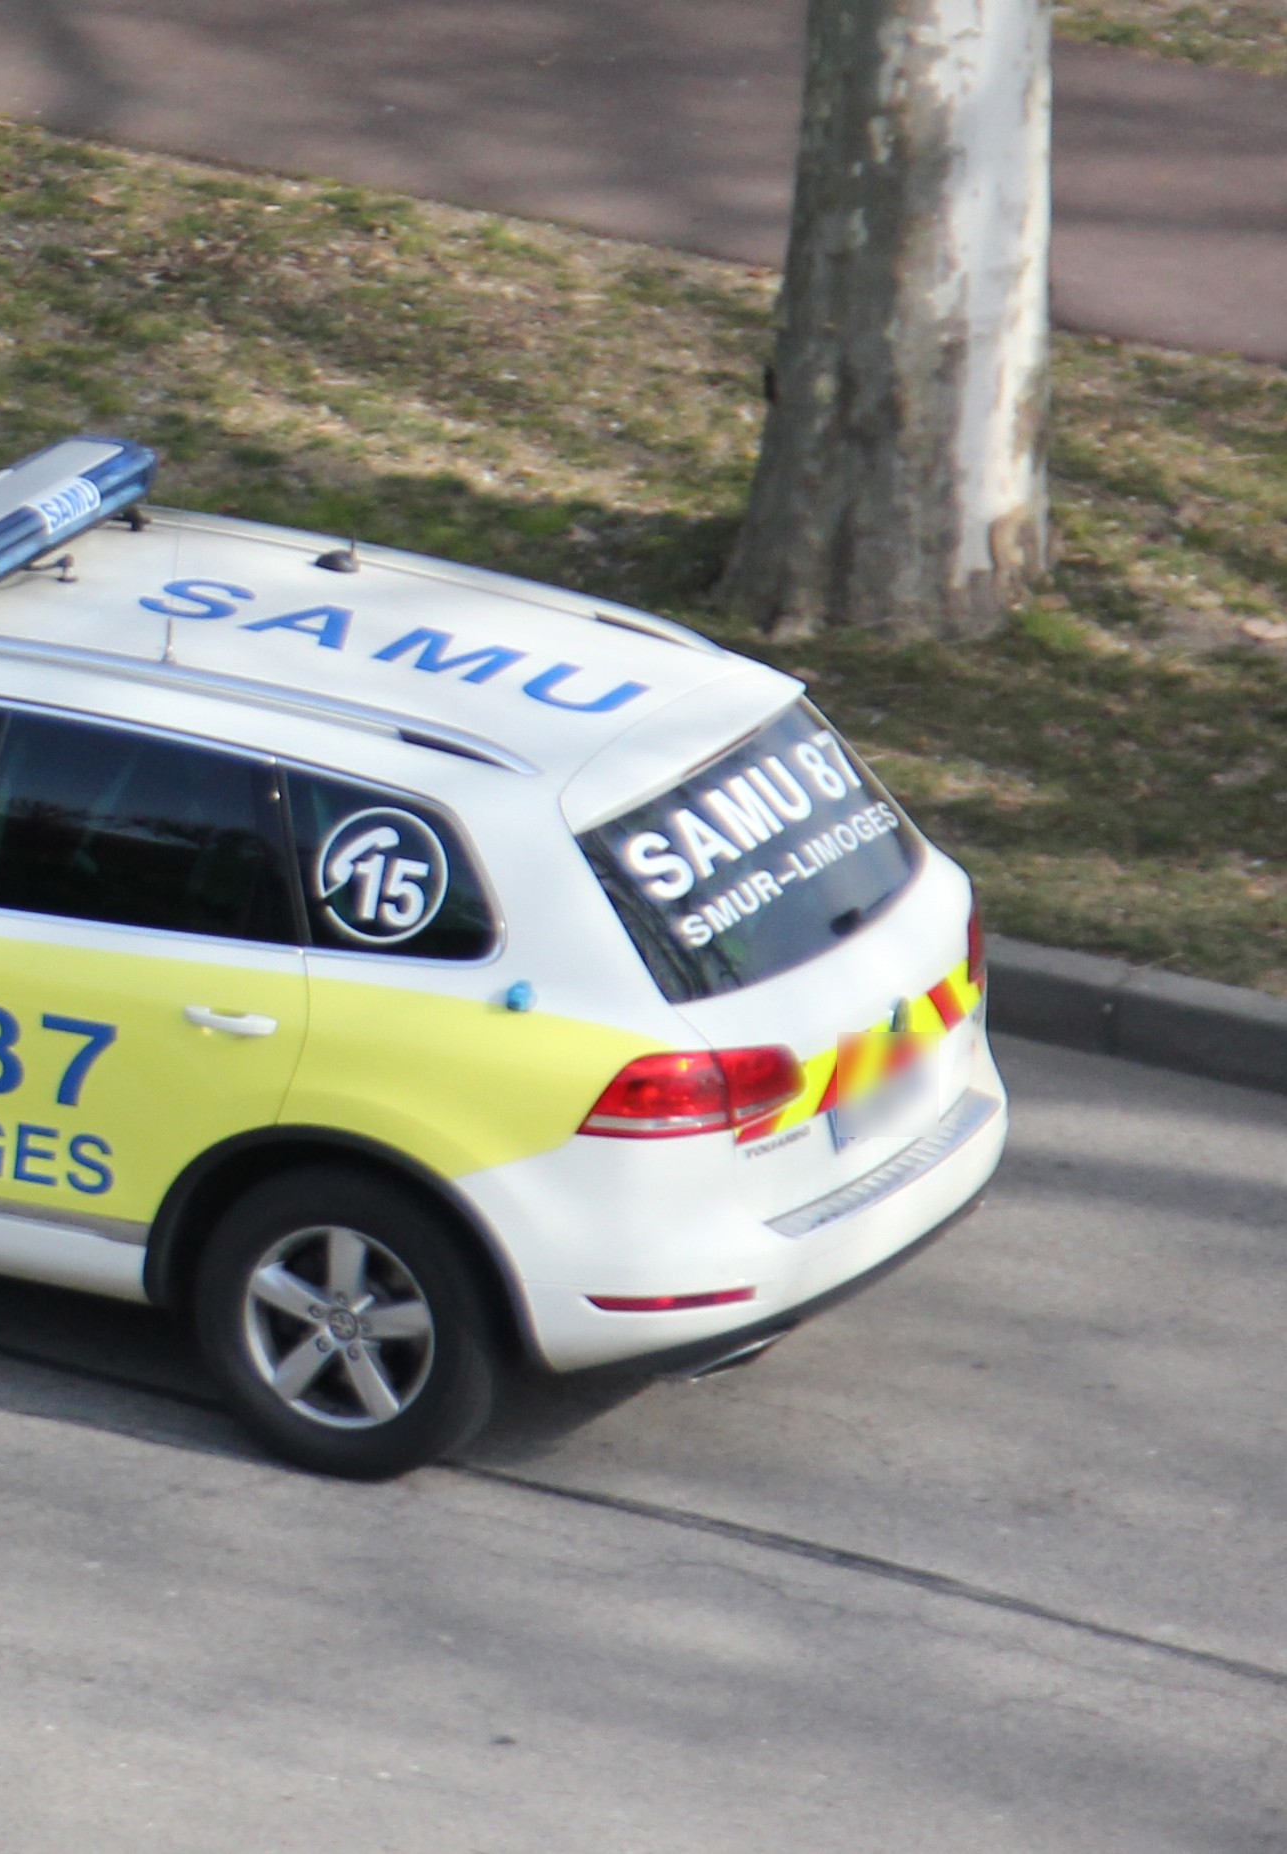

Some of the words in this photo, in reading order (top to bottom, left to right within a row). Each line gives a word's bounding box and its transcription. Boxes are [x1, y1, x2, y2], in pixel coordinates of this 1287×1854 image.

[40, 479, 99, 528] SAMU
[139, 577, 651, 715] SAMU
[624, 756, 812, 901] SAMU
[796, 730, 862, 800] 87
[356, 853, 430, 928] 15
